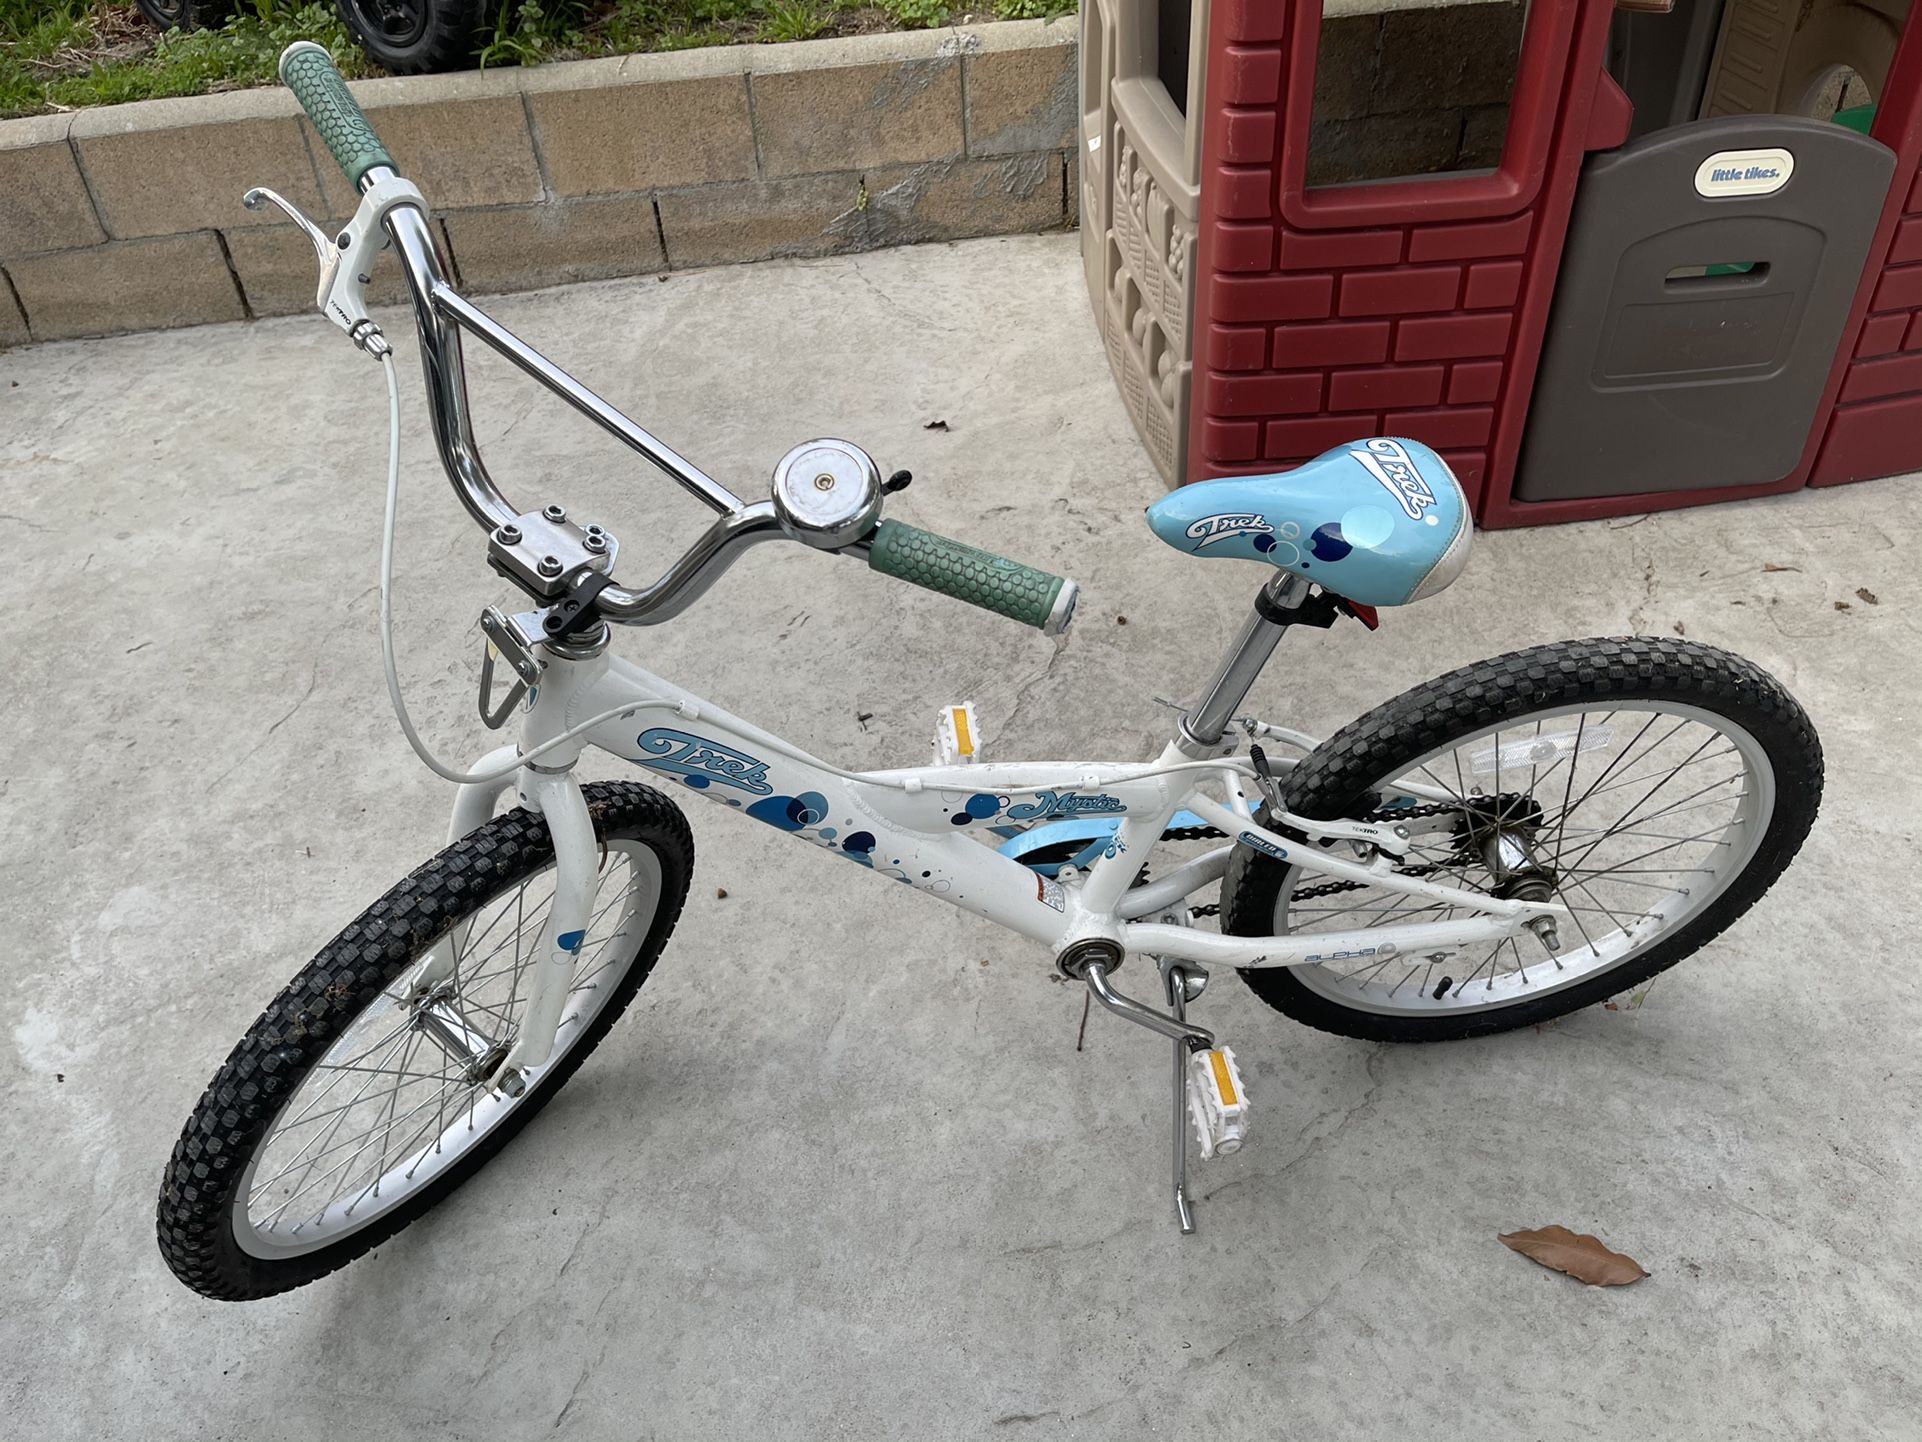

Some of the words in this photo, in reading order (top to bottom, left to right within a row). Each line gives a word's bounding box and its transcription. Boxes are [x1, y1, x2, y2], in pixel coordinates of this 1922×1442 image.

[1711, 168, 1743, 182] little
[1349, 438, 1438, 521] Trek
[1185, 512, 1274, 552] Trek
[628, 727, 773, 795] Trek
[1007, 790, 1128, 822] Mystic
